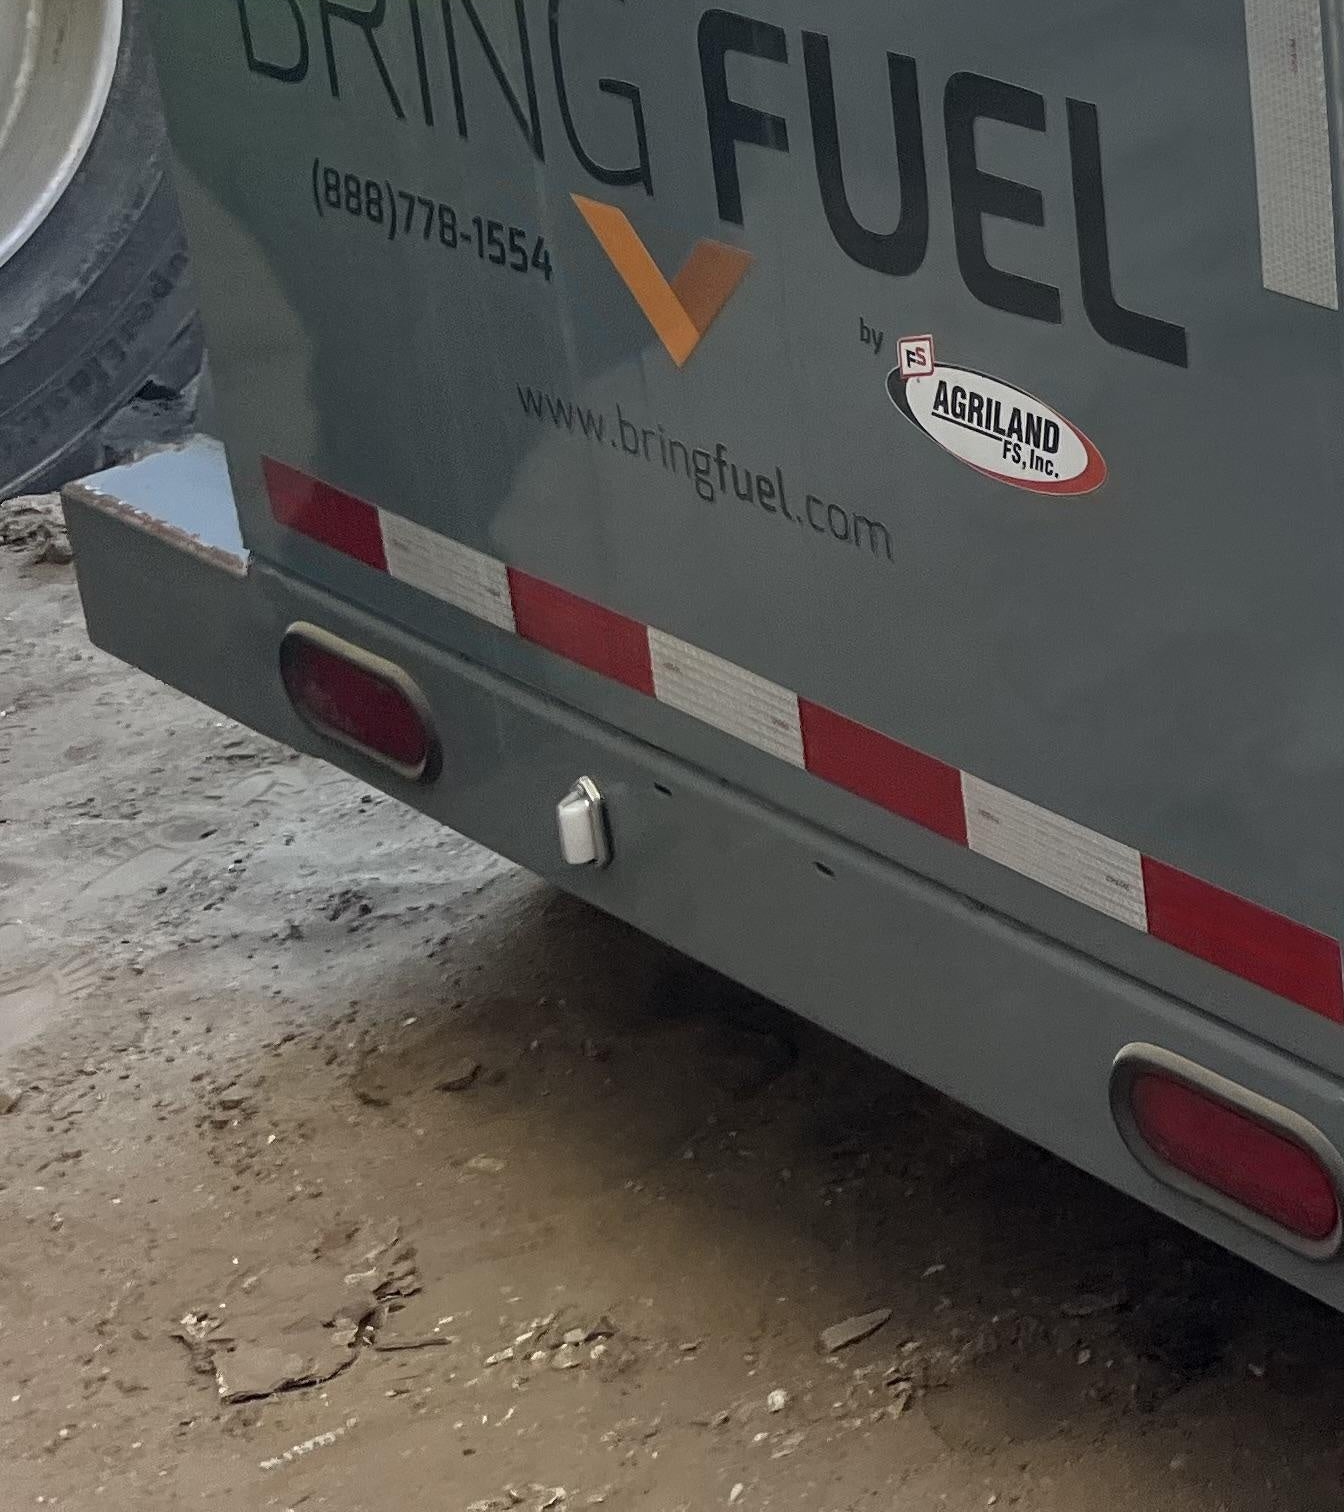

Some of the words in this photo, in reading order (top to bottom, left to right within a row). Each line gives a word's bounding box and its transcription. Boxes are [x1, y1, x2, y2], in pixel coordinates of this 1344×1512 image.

[312, 157, 553, 282] (888)778-1554
[697, 8, 1188, 369] FUEL
[859, 317, 884, 355] by
[906, 347, 926, 369] FS
[933, 381, 1060, 455] AGRILAND
[517, 383, 896, 562] www.bringfuel.com
[1029, 448, 1060, 479] Inc.
